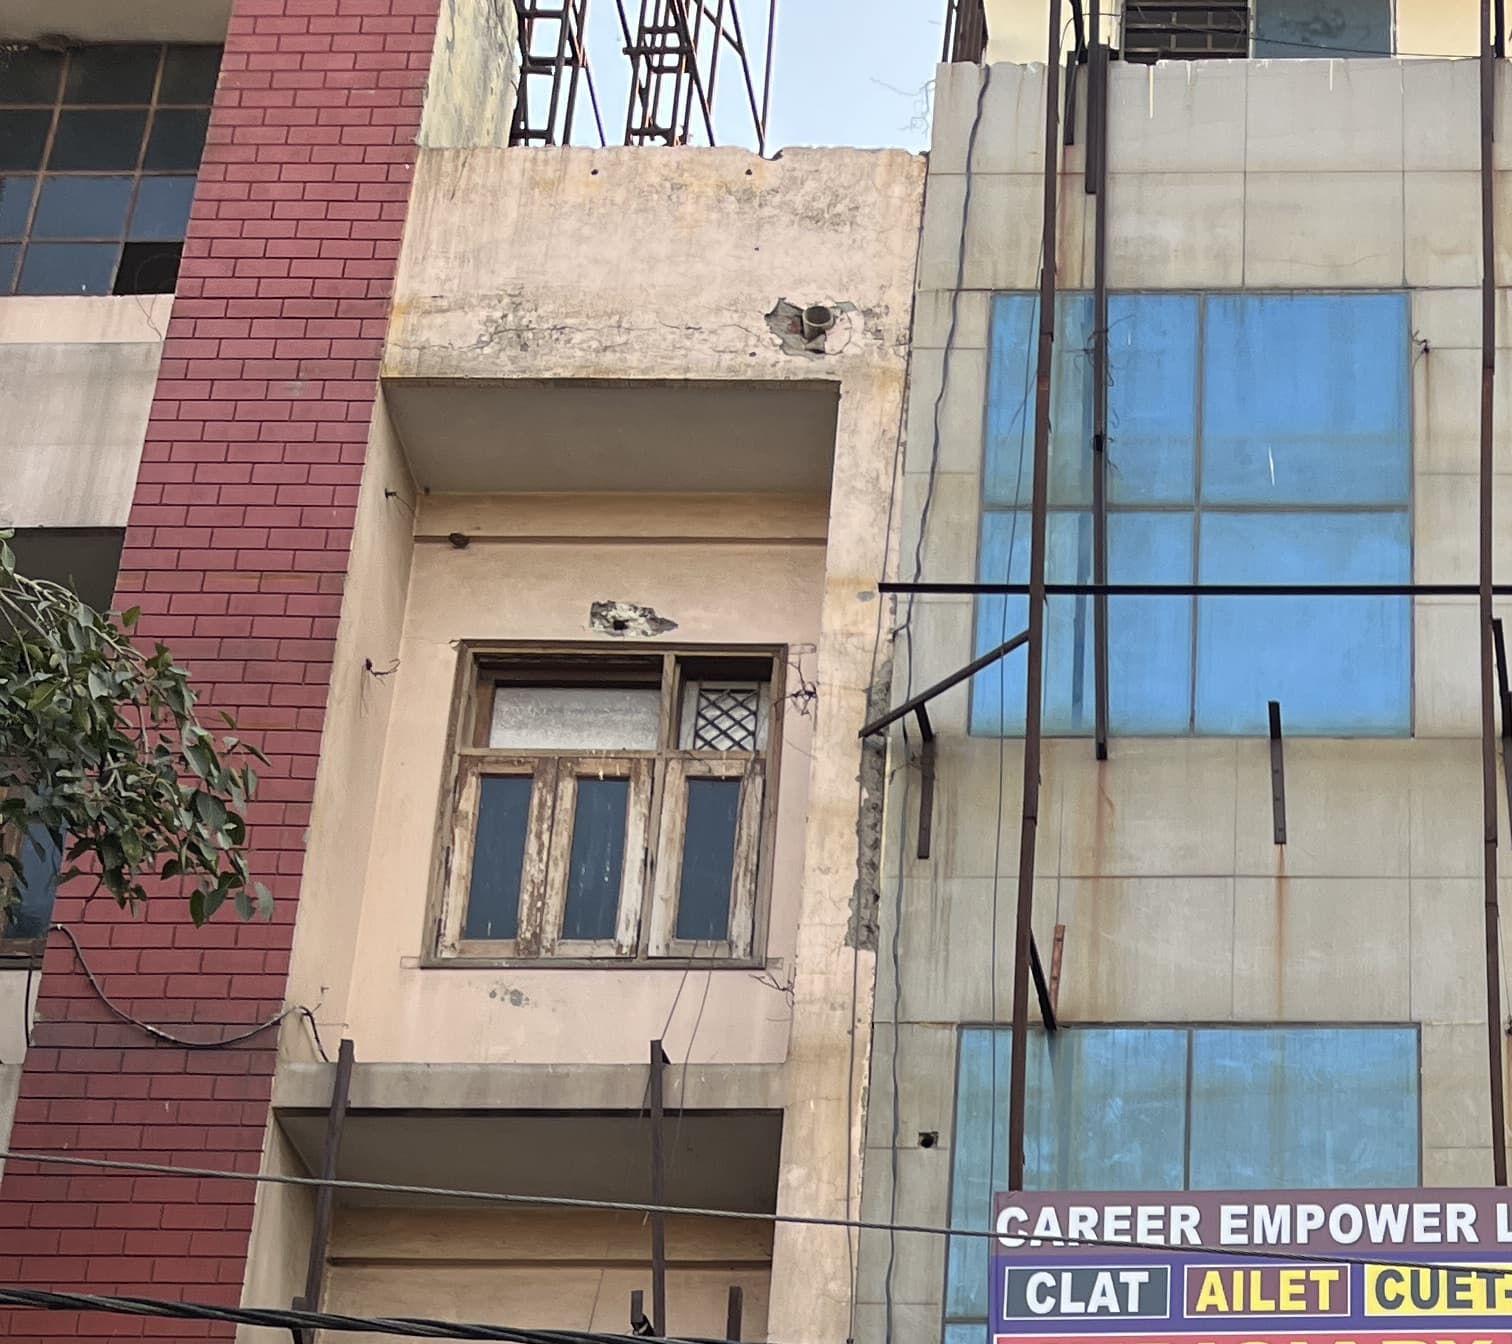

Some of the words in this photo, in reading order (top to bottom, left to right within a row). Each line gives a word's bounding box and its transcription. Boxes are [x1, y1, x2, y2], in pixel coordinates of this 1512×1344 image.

[998, 1206, 1202, 1248] CAREER
[1219, 1203, 1475, 1245] EMPOWER
[1025, 1271, 1148, 1313] CLAT
[1196, 1269, 1339, 1311] AILET
